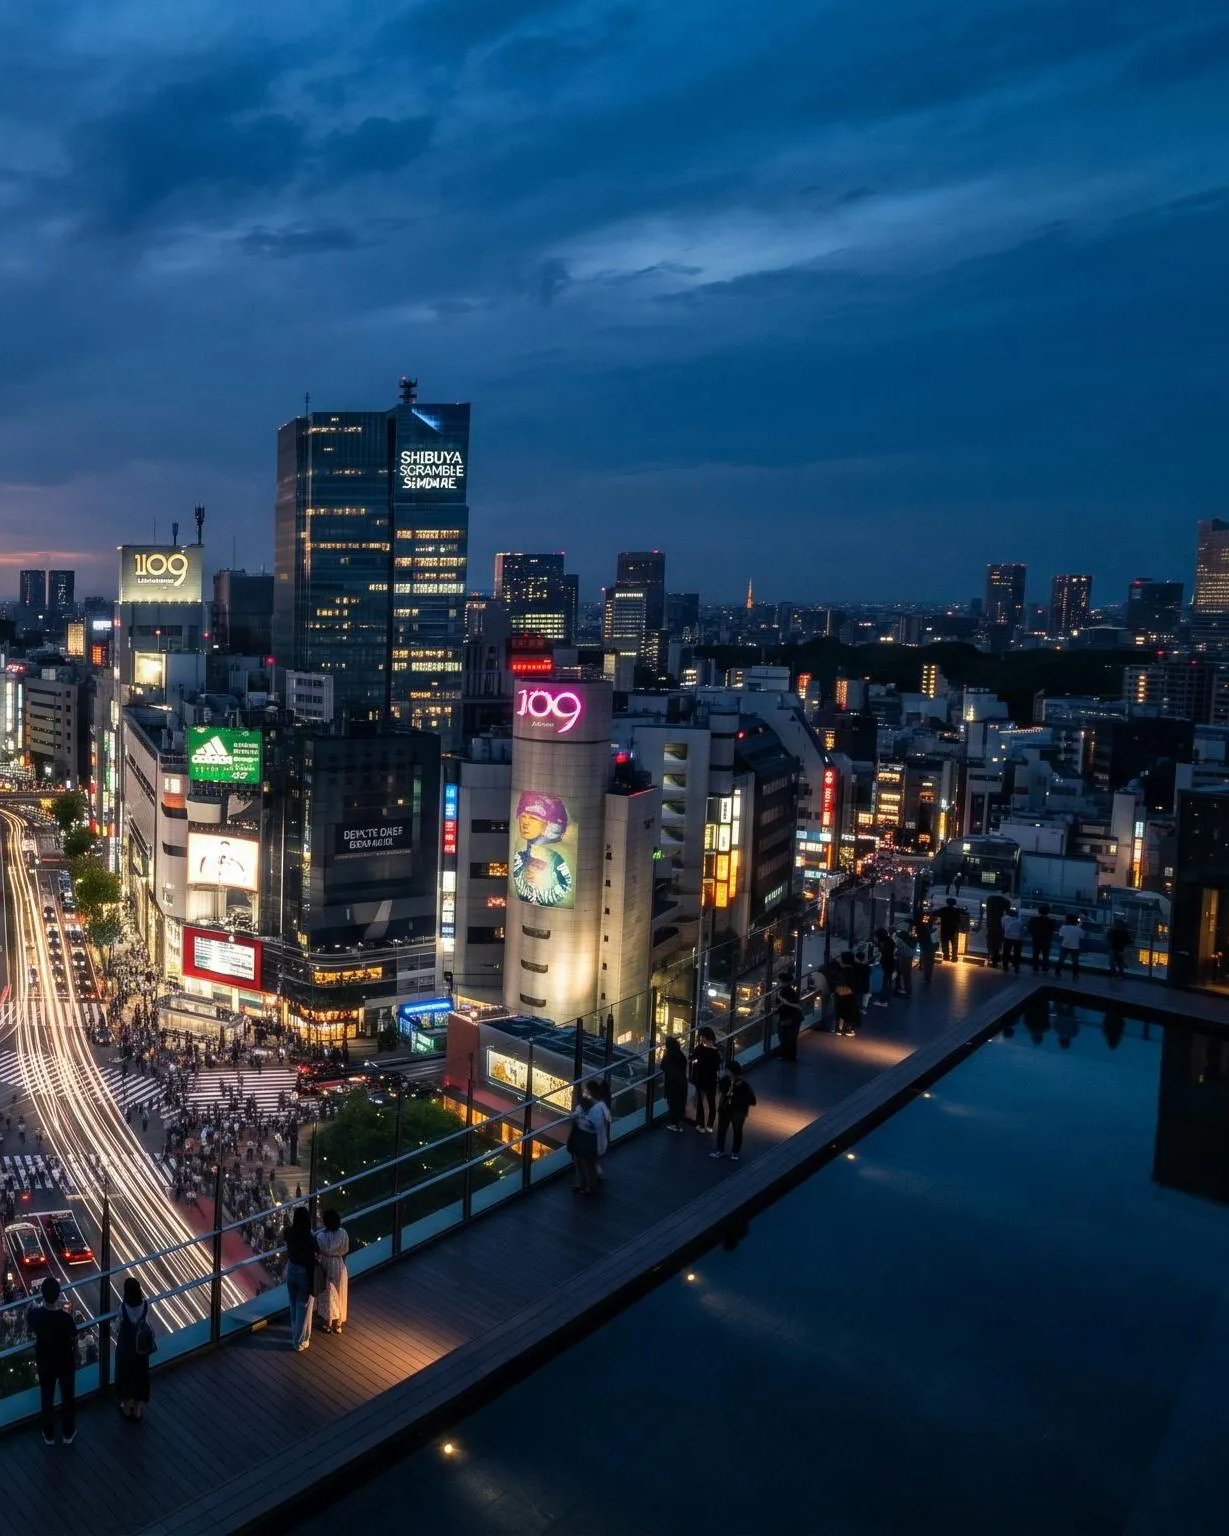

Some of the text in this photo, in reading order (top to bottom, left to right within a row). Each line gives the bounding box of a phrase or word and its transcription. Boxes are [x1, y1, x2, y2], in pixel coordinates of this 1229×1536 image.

[401, 451, 462, 464] SHIBUYA
[400, 465, 464, 476] SCRAMBLE
[516, 690, 582, 733] 109
